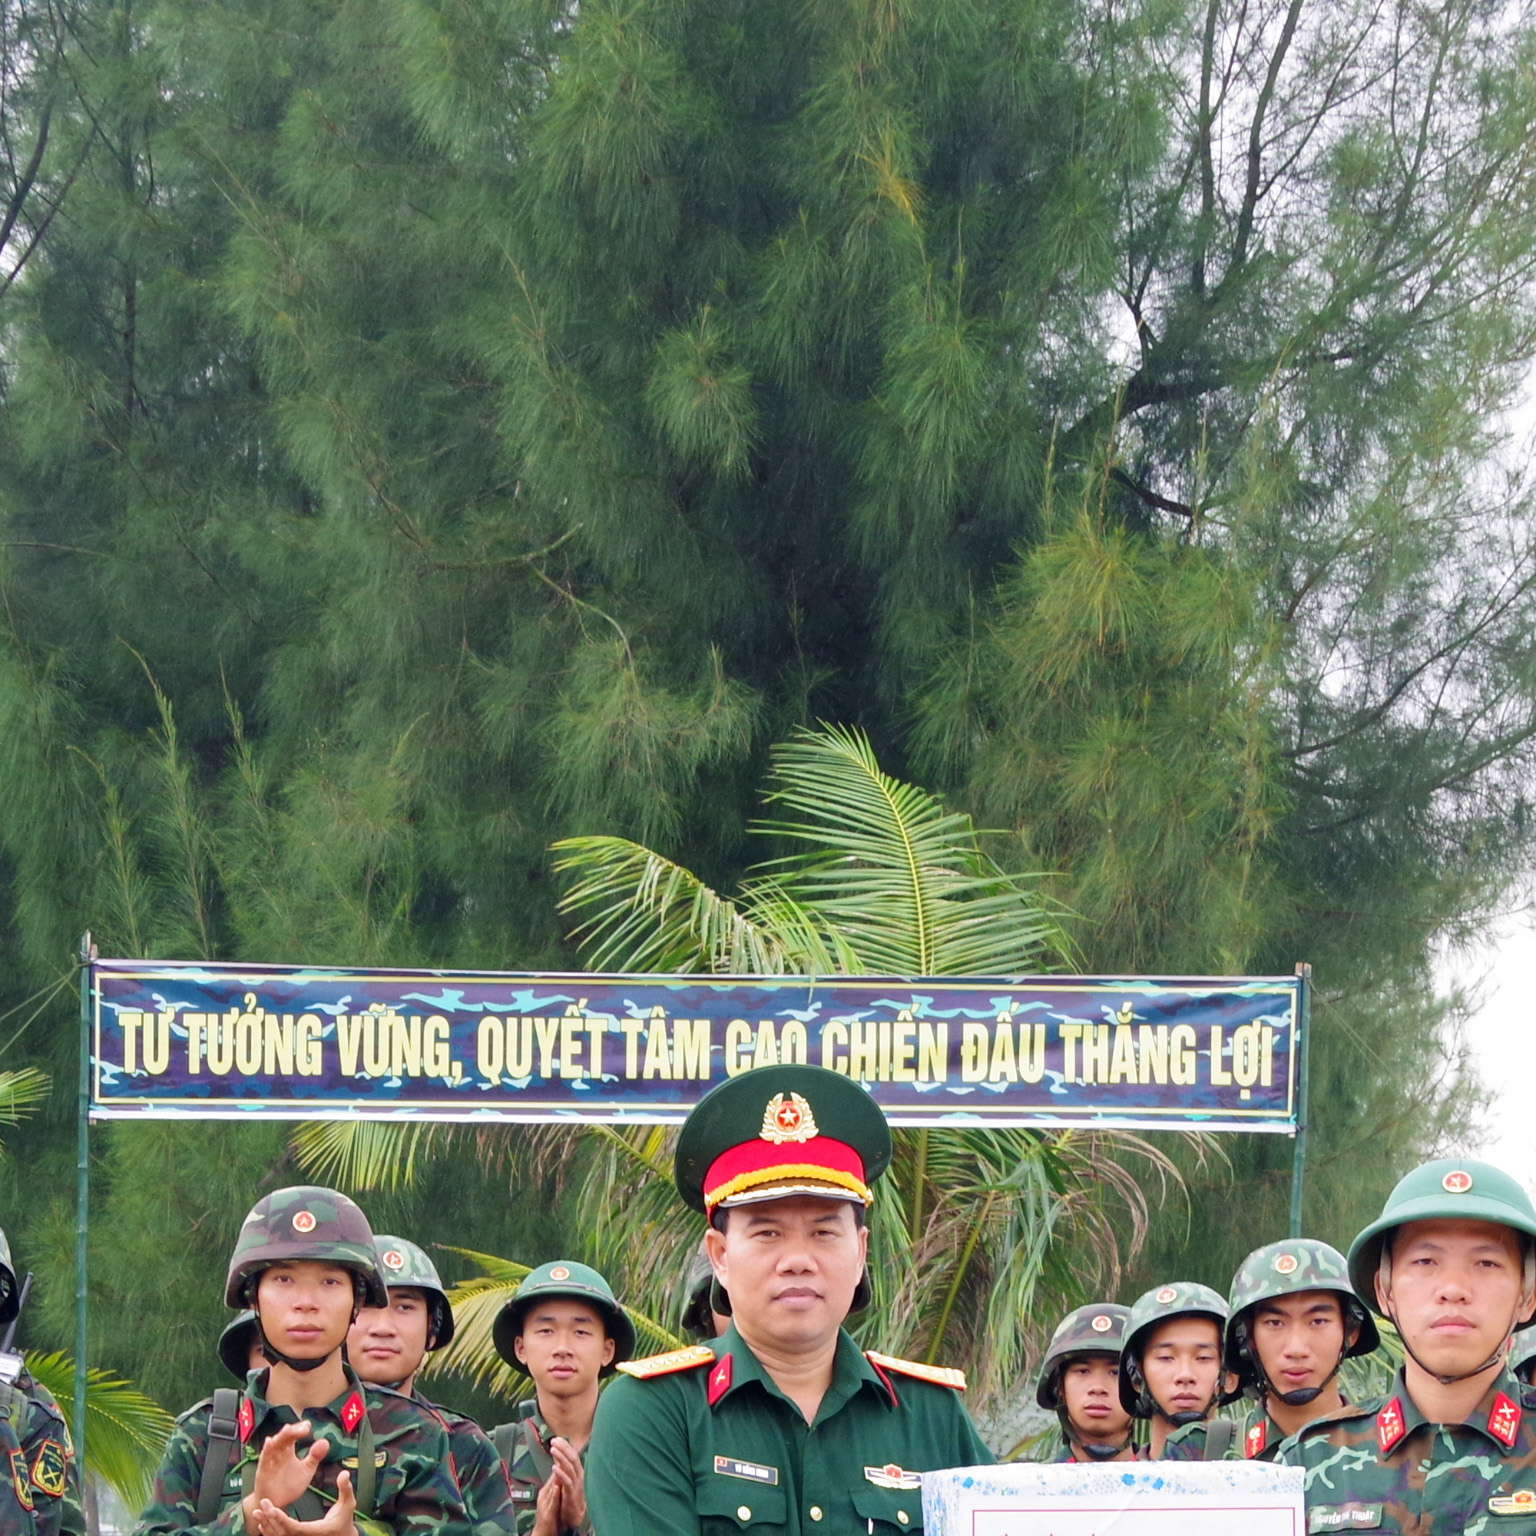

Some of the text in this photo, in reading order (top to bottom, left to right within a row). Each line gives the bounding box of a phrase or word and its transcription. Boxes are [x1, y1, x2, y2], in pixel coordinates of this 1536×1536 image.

[118, 992, 1273, 1100] TƯ TƯỞNG VỮNG, QUYẾT TÂM CAO CHIẾN ĐẤU THẮNG LỢI
